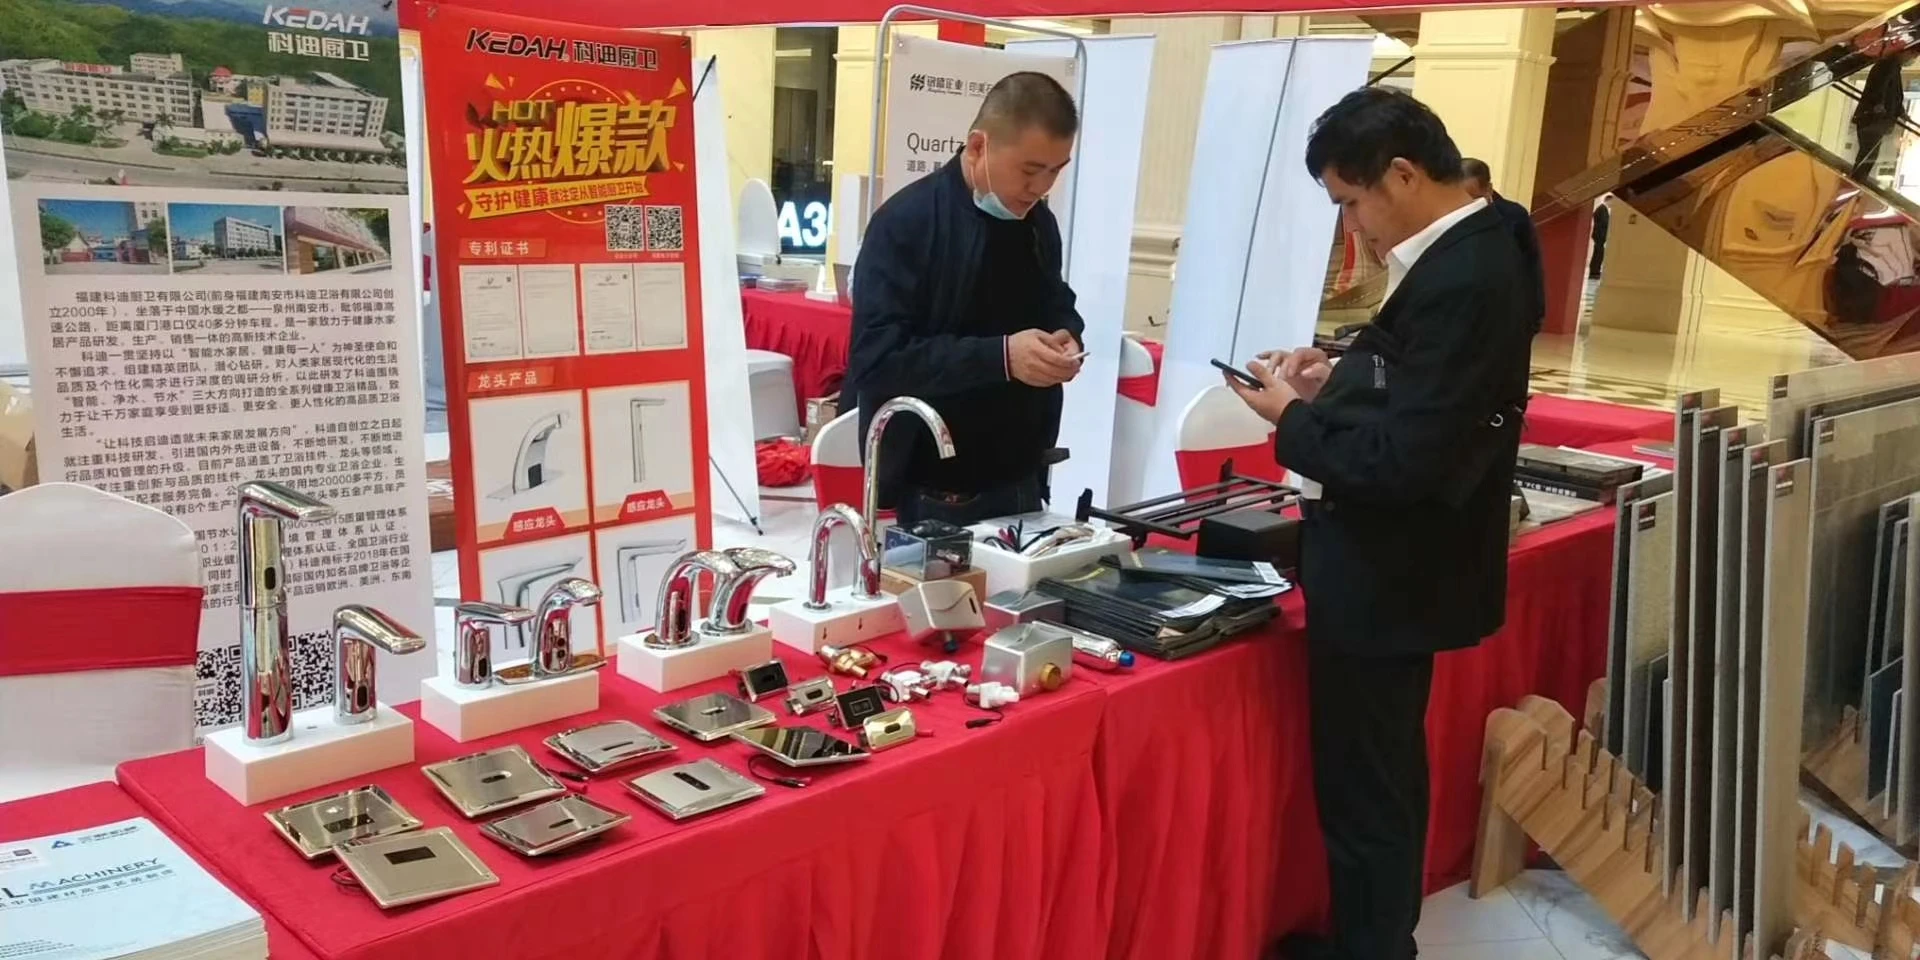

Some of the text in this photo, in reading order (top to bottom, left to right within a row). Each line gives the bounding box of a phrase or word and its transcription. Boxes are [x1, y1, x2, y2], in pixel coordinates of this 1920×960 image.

[263, 4, 368, 36] KEDAH
[268, 31, 370, 62] 科迪厨卫
[465, 27, 658, 71] KEDAH 科迪厨卫
[491, 99, 556, 122] HOT
[463, 91, 677, 184] 火热爆款
[777, 201, 833, 247] A3
[468, 241, 529, 256] 专利证书
[477, 371, 537, 389] 龙头产品
[627, 498, 665, 513] 感应龙头
[512, 515, 556, 533] 感应龙头
[30, 857, 159, 890] MACHINERY
